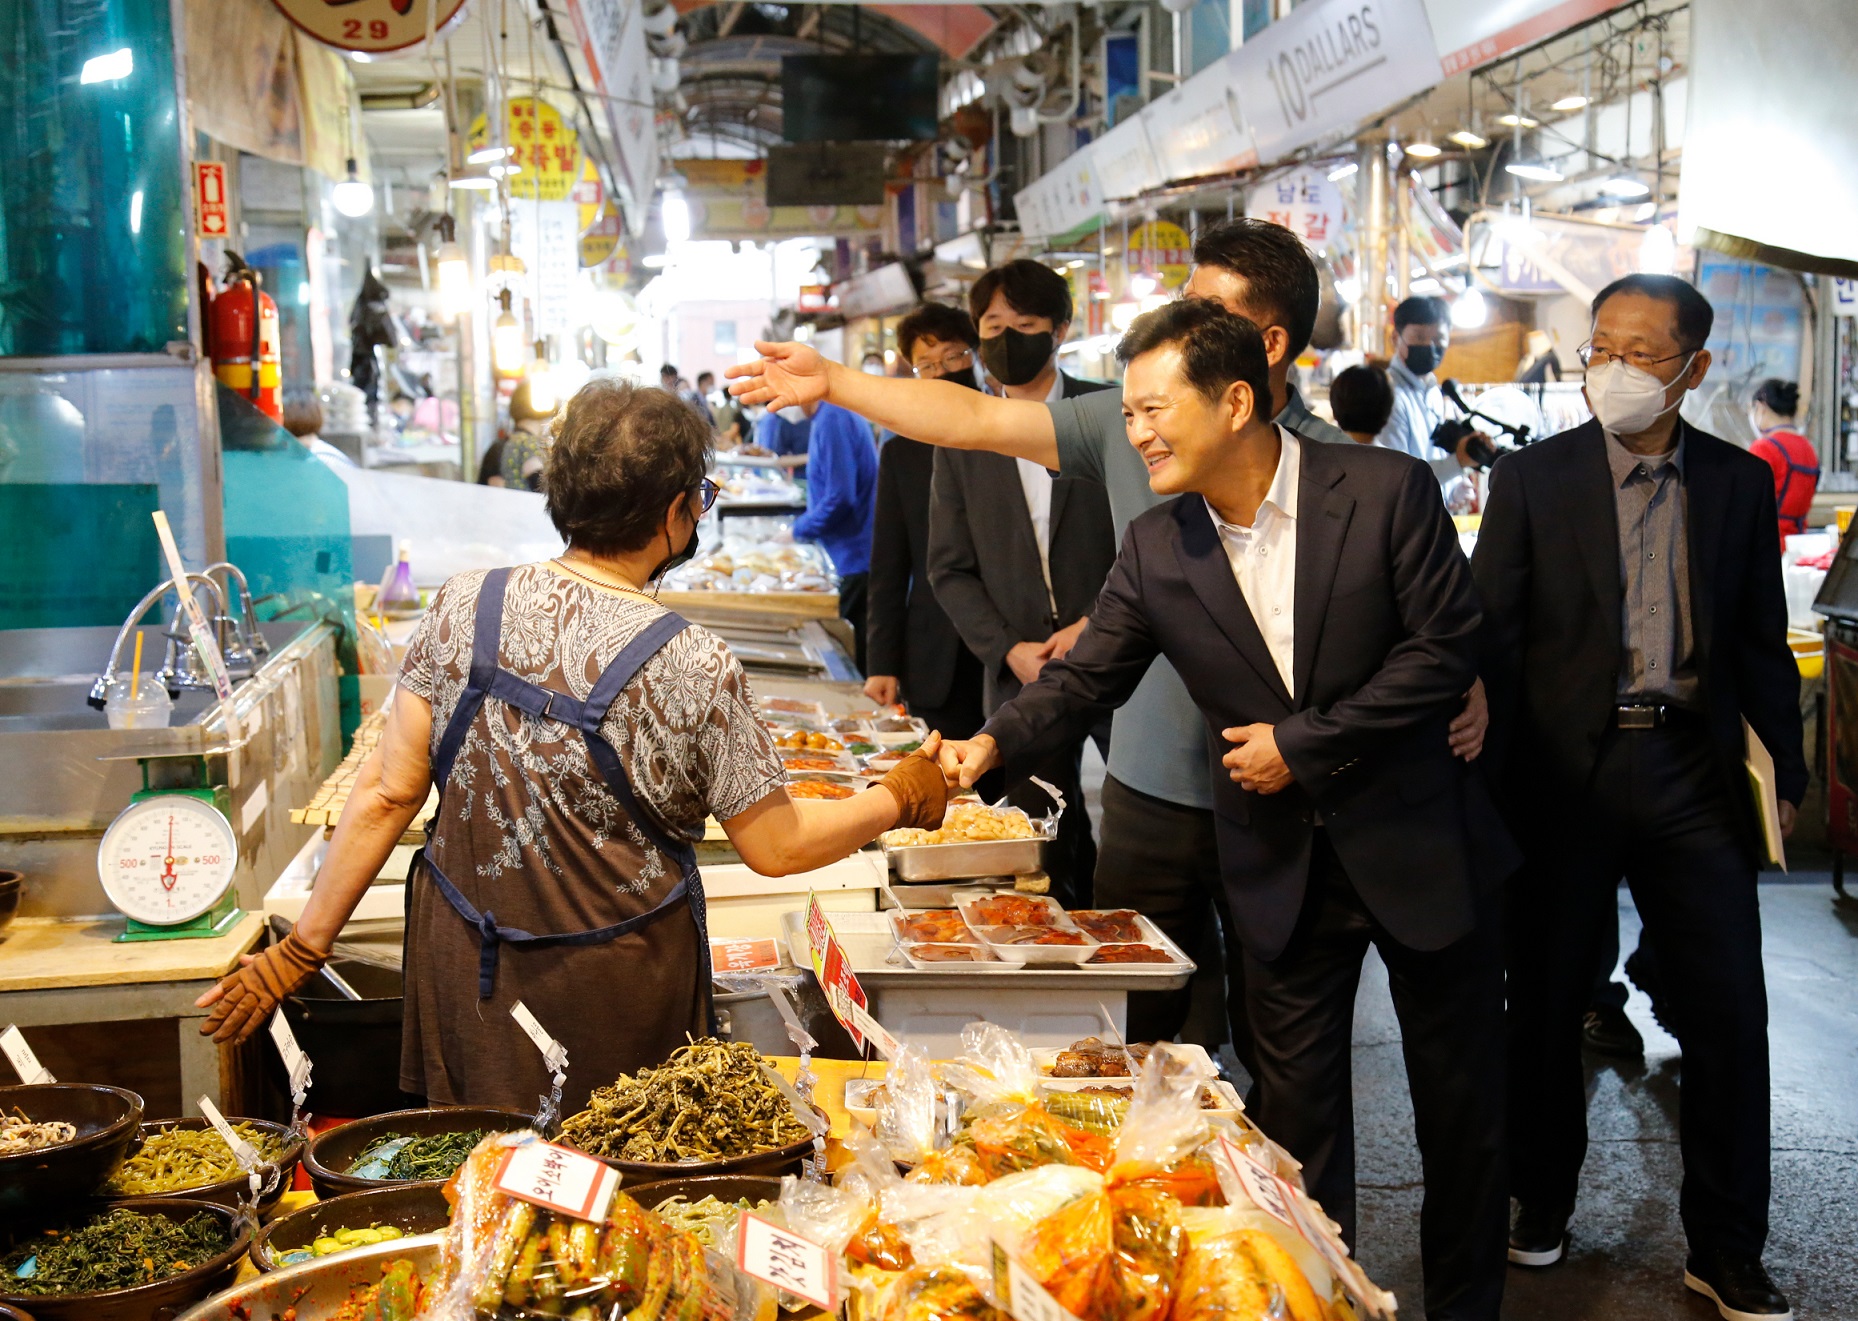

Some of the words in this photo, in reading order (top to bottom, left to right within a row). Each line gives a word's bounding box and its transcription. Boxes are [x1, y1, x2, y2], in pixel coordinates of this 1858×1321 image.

[342, 18, 390, 40] 29
[1276, 182, 1322, 204] 남도
[119, 858, 138, 869] 500
[202, 855, 220, 865] 500
[532, 1148, 574, 1202] 오이소박이
[768, 1233, 808, 1288] 갓김치
